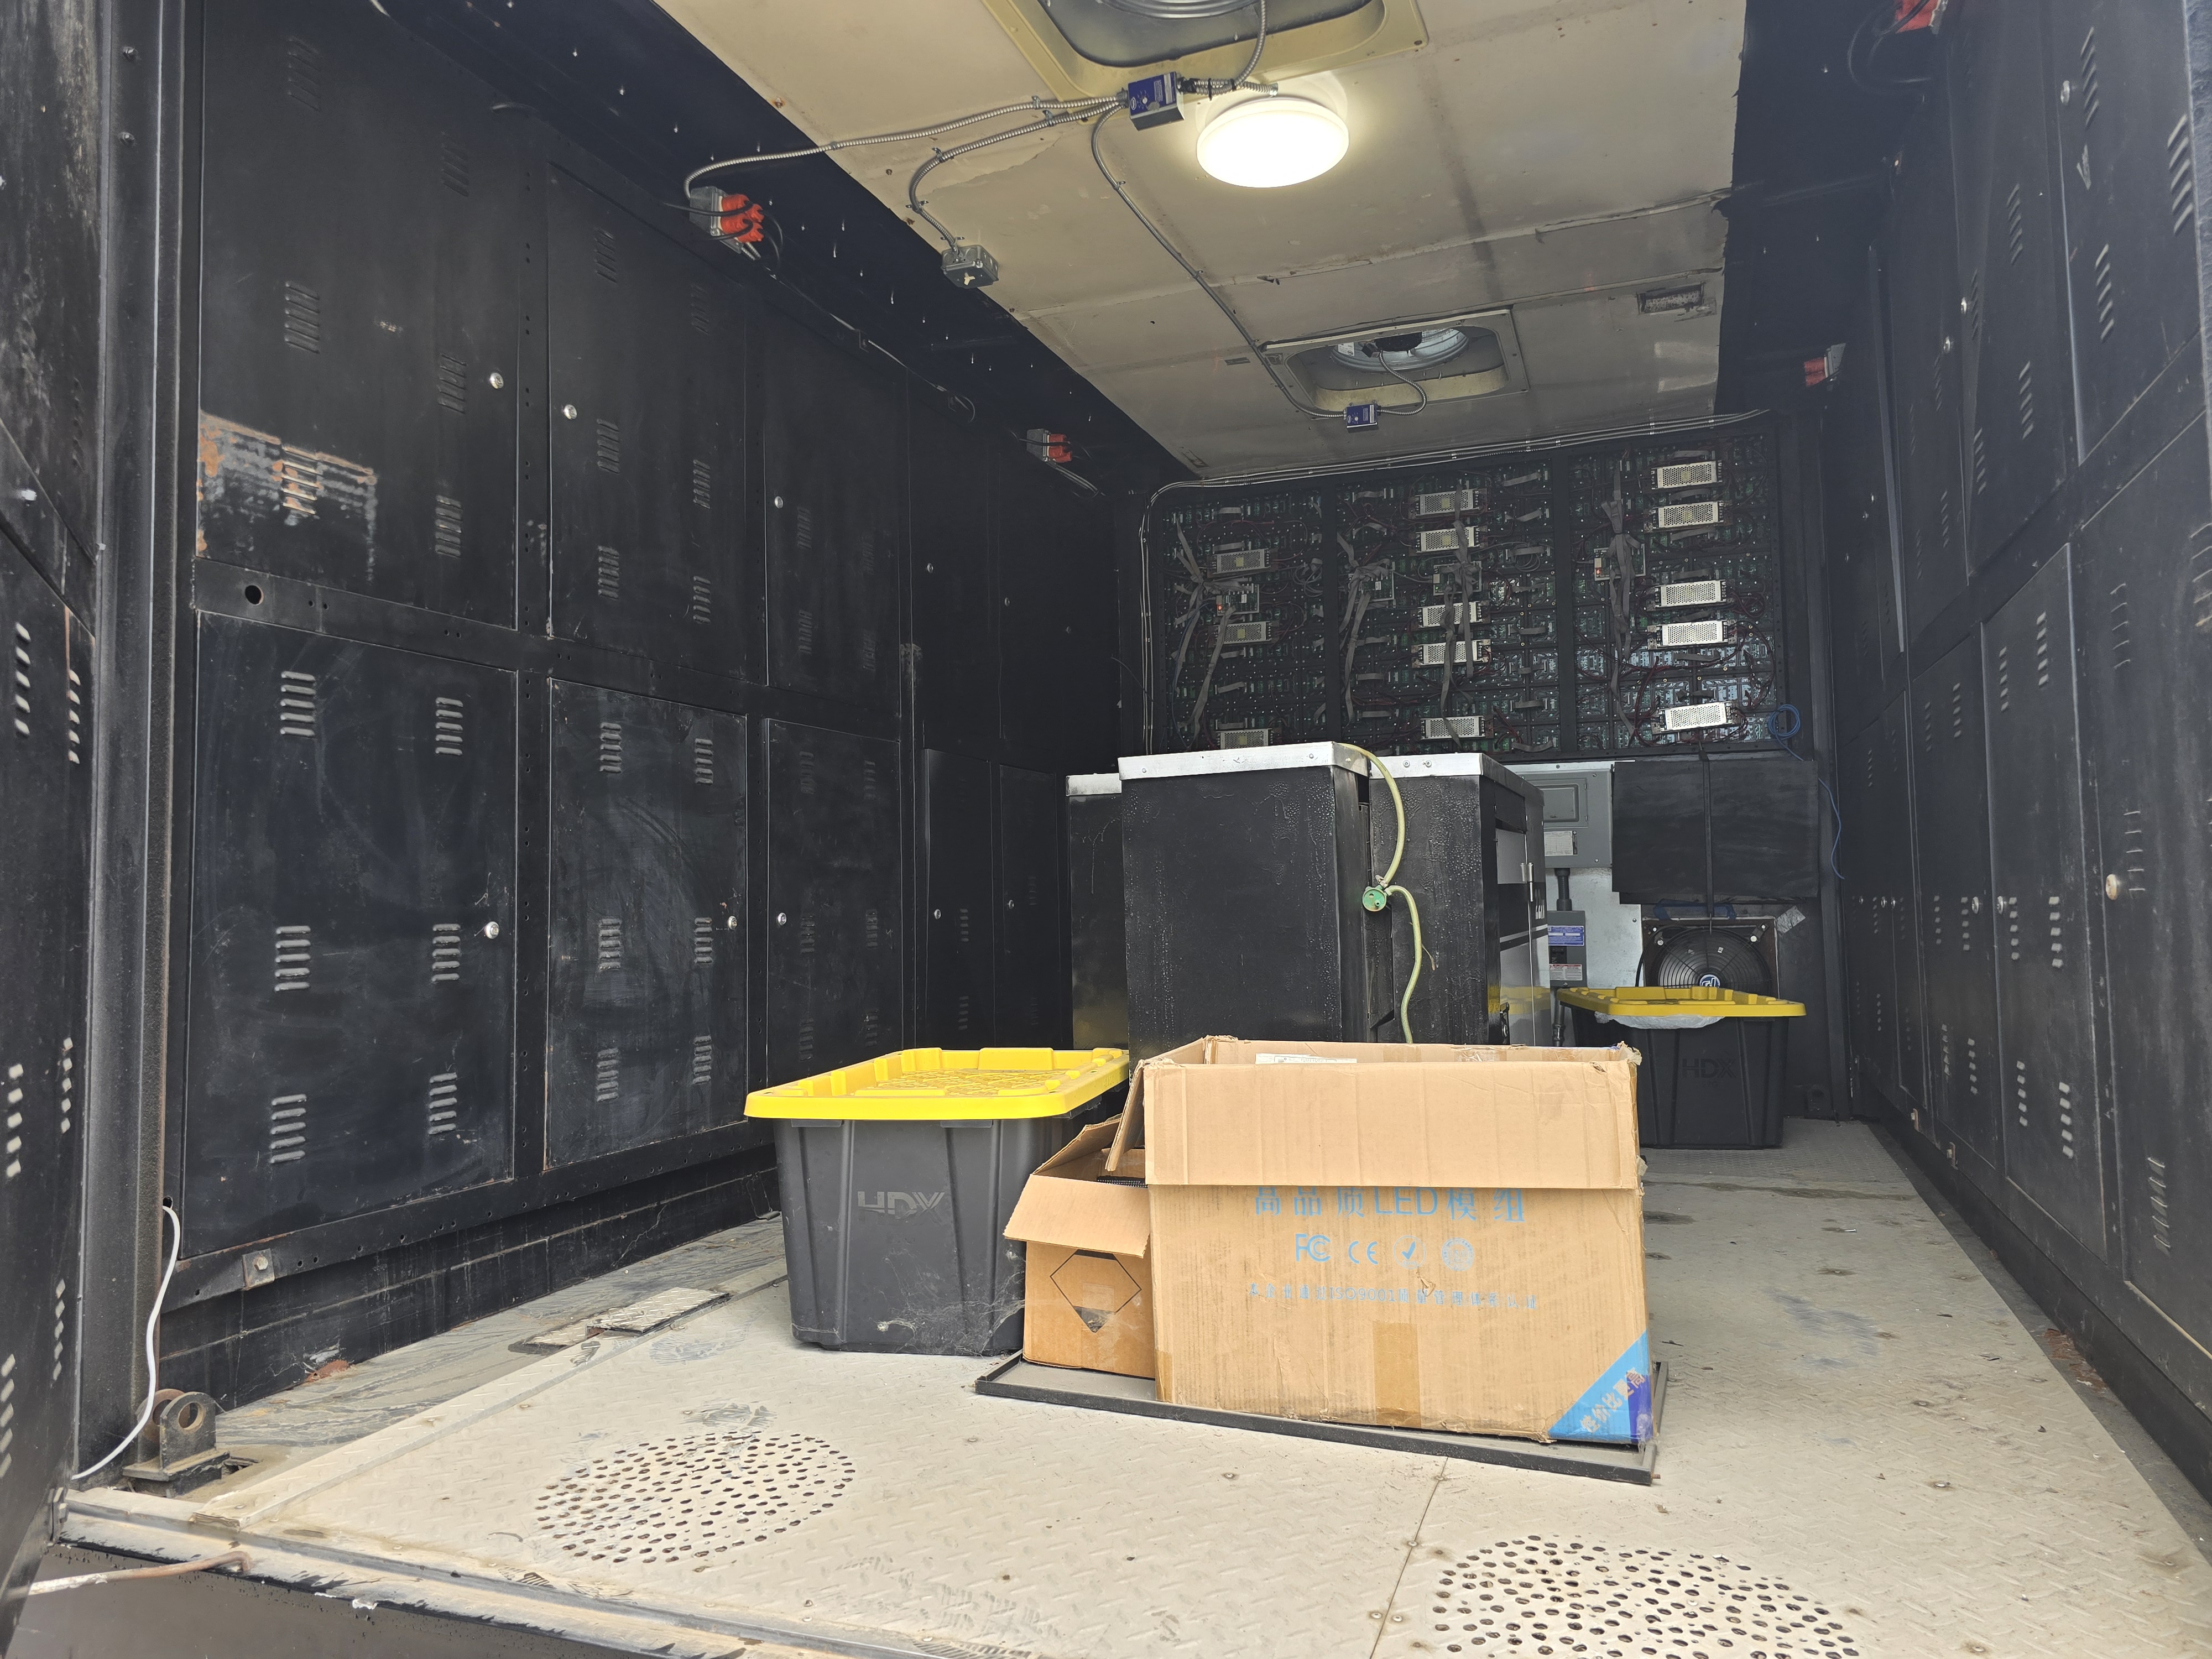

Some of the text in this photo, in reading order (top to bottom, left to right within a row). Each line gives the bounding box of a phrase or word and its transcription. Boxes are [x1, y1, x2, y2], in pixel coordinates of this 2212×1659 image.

[1682, 1058, 1736, 1078] HDX
[857, 1191, 946, 1225] HDX
[1348, 1241, 1379, 1265] CE
